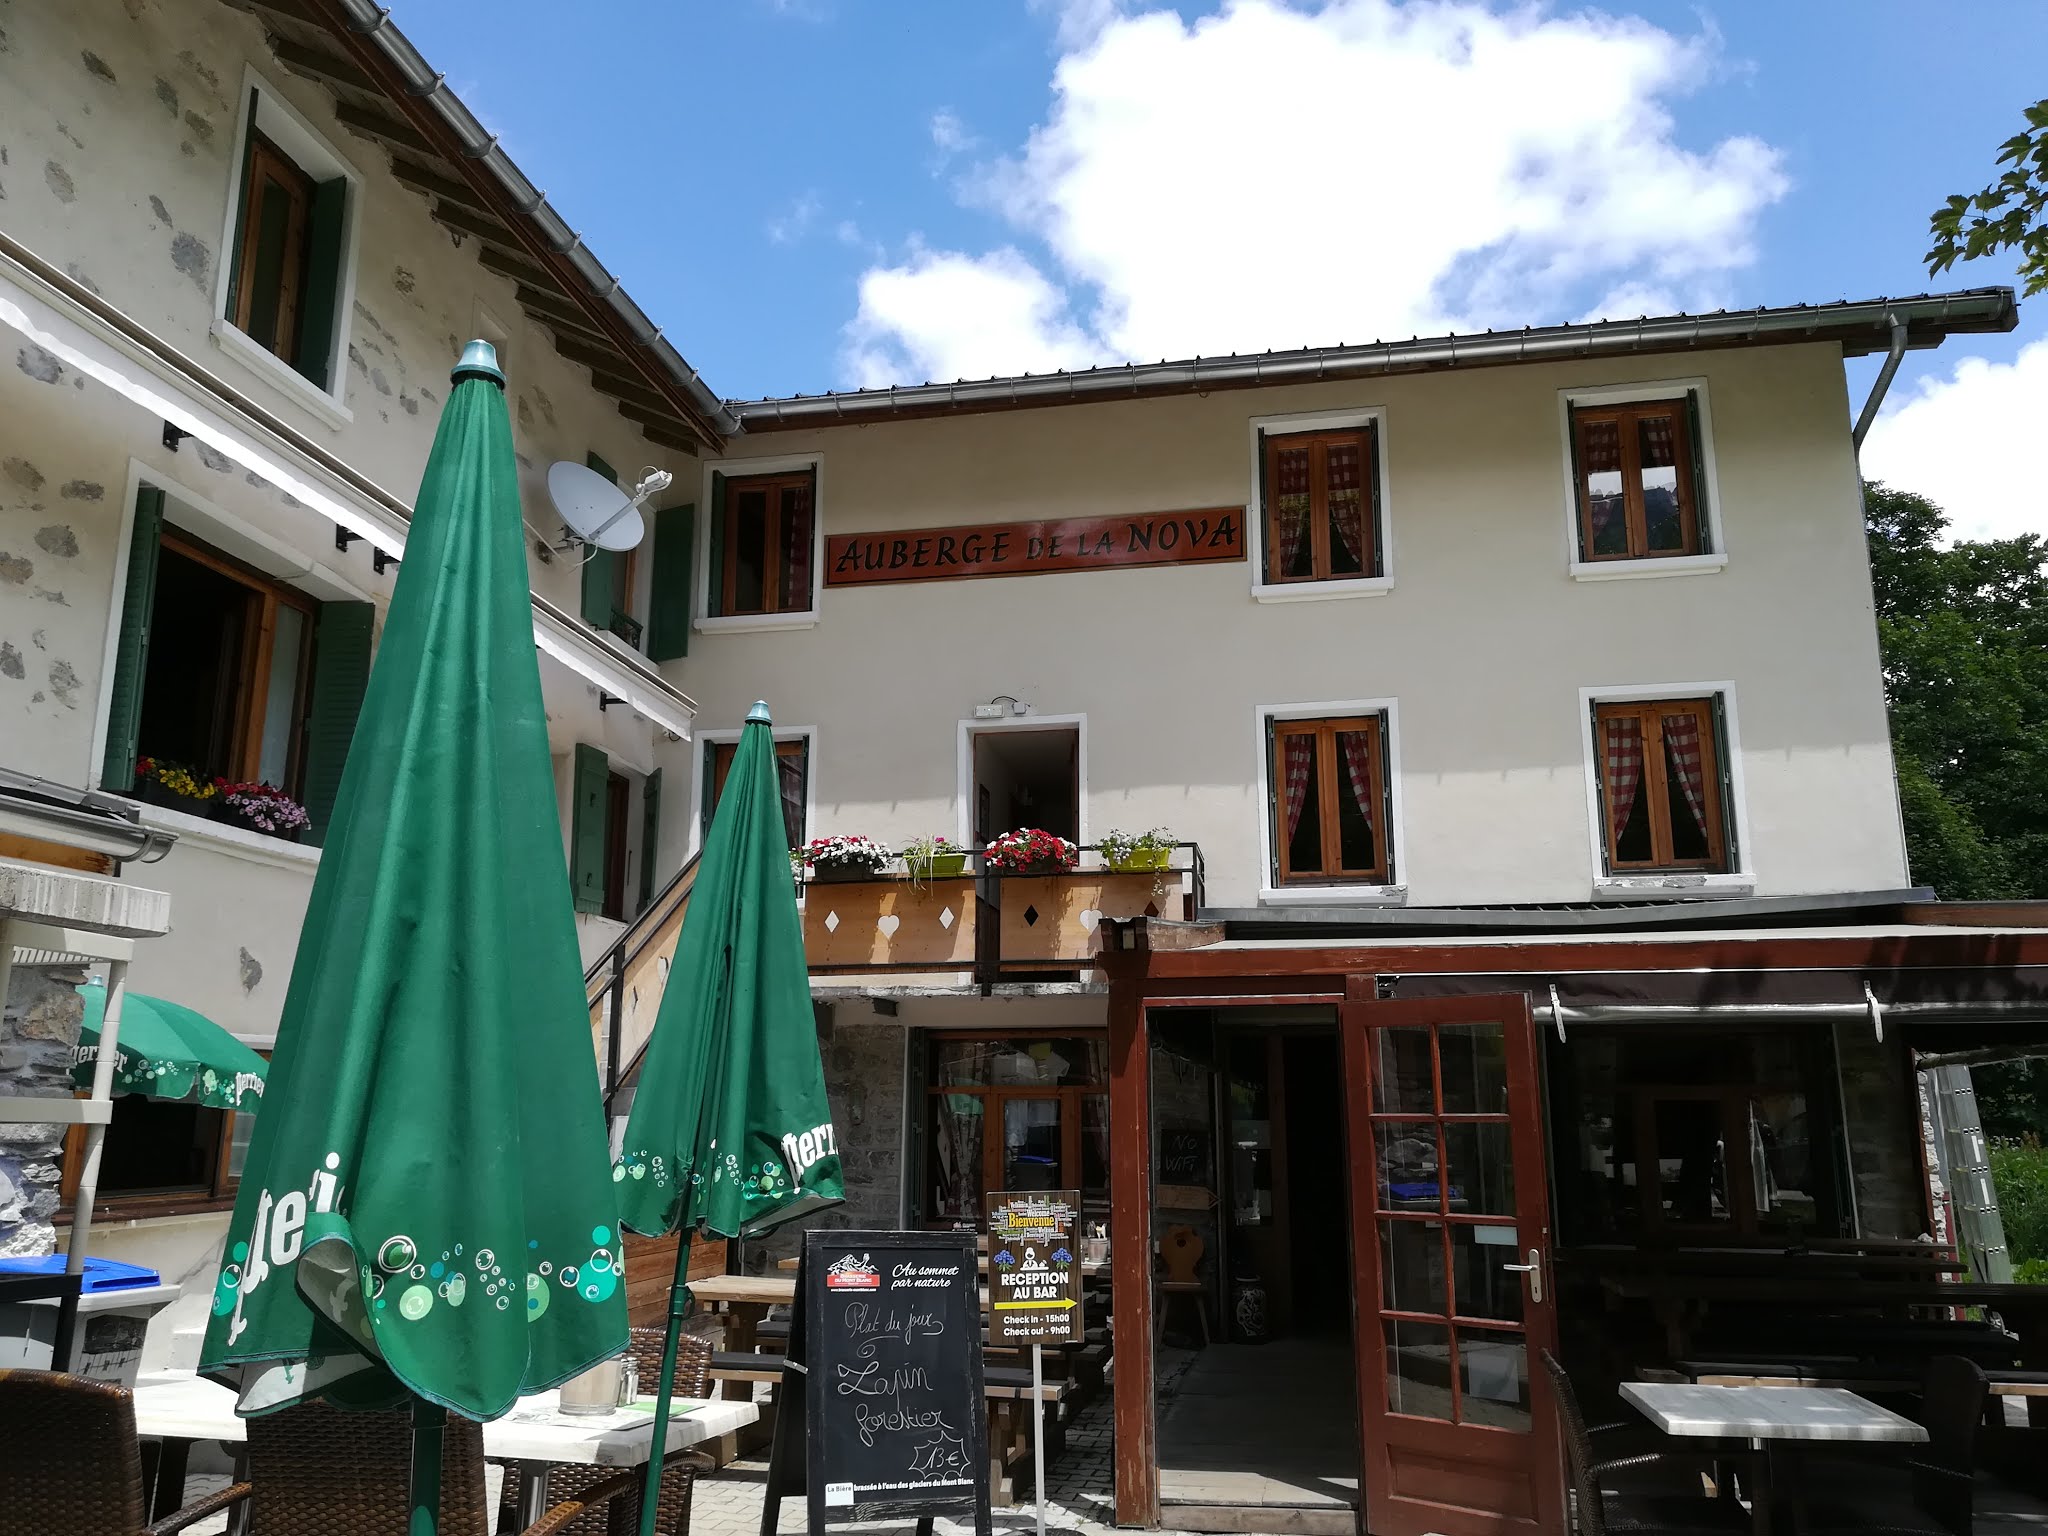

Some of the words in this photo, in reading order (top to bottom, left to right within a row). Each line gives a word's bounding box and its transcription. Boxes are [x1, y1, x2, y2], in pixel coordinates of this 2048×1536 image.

[835, 532, 1012, 573] AUBERGE
[1026, 534, 1063, 560] DE
[1076, 529, 1114, 557] LA
[1127, 515, 1239, 553] NOVA
[1008, 1212, 1055, 1227] Bienvenue
[892, 1262, 917, 1277] Au
[918, 1266, 960, 1276] sommet
[891, 1278, 914, 1291] par
[914, 1278, 951, 1287] nature
[1001, 1272, 1069, 1286] RECEPTION
[1013, 1287, 1031, 1299] AU
[1034, 1286, 1057, 1299] BAR
[845, 1302, 880, 1338] Plat
[885, 1310, 901, 1332] du
[1003, 1315, 1030, 1324] Check
[1045, 1313, 1070, 1323] 15h00
[1003, 1327, 1030, 1336] Check
[1031, 1327, 1044, 1335] out
[1050, 1326, 1071, 1335] 9h00
[838, 1361, 933, 1412] Lapin
[854, 1483, 877, 1491] brassée
[909, 1480, 932, 1489] glaciers
